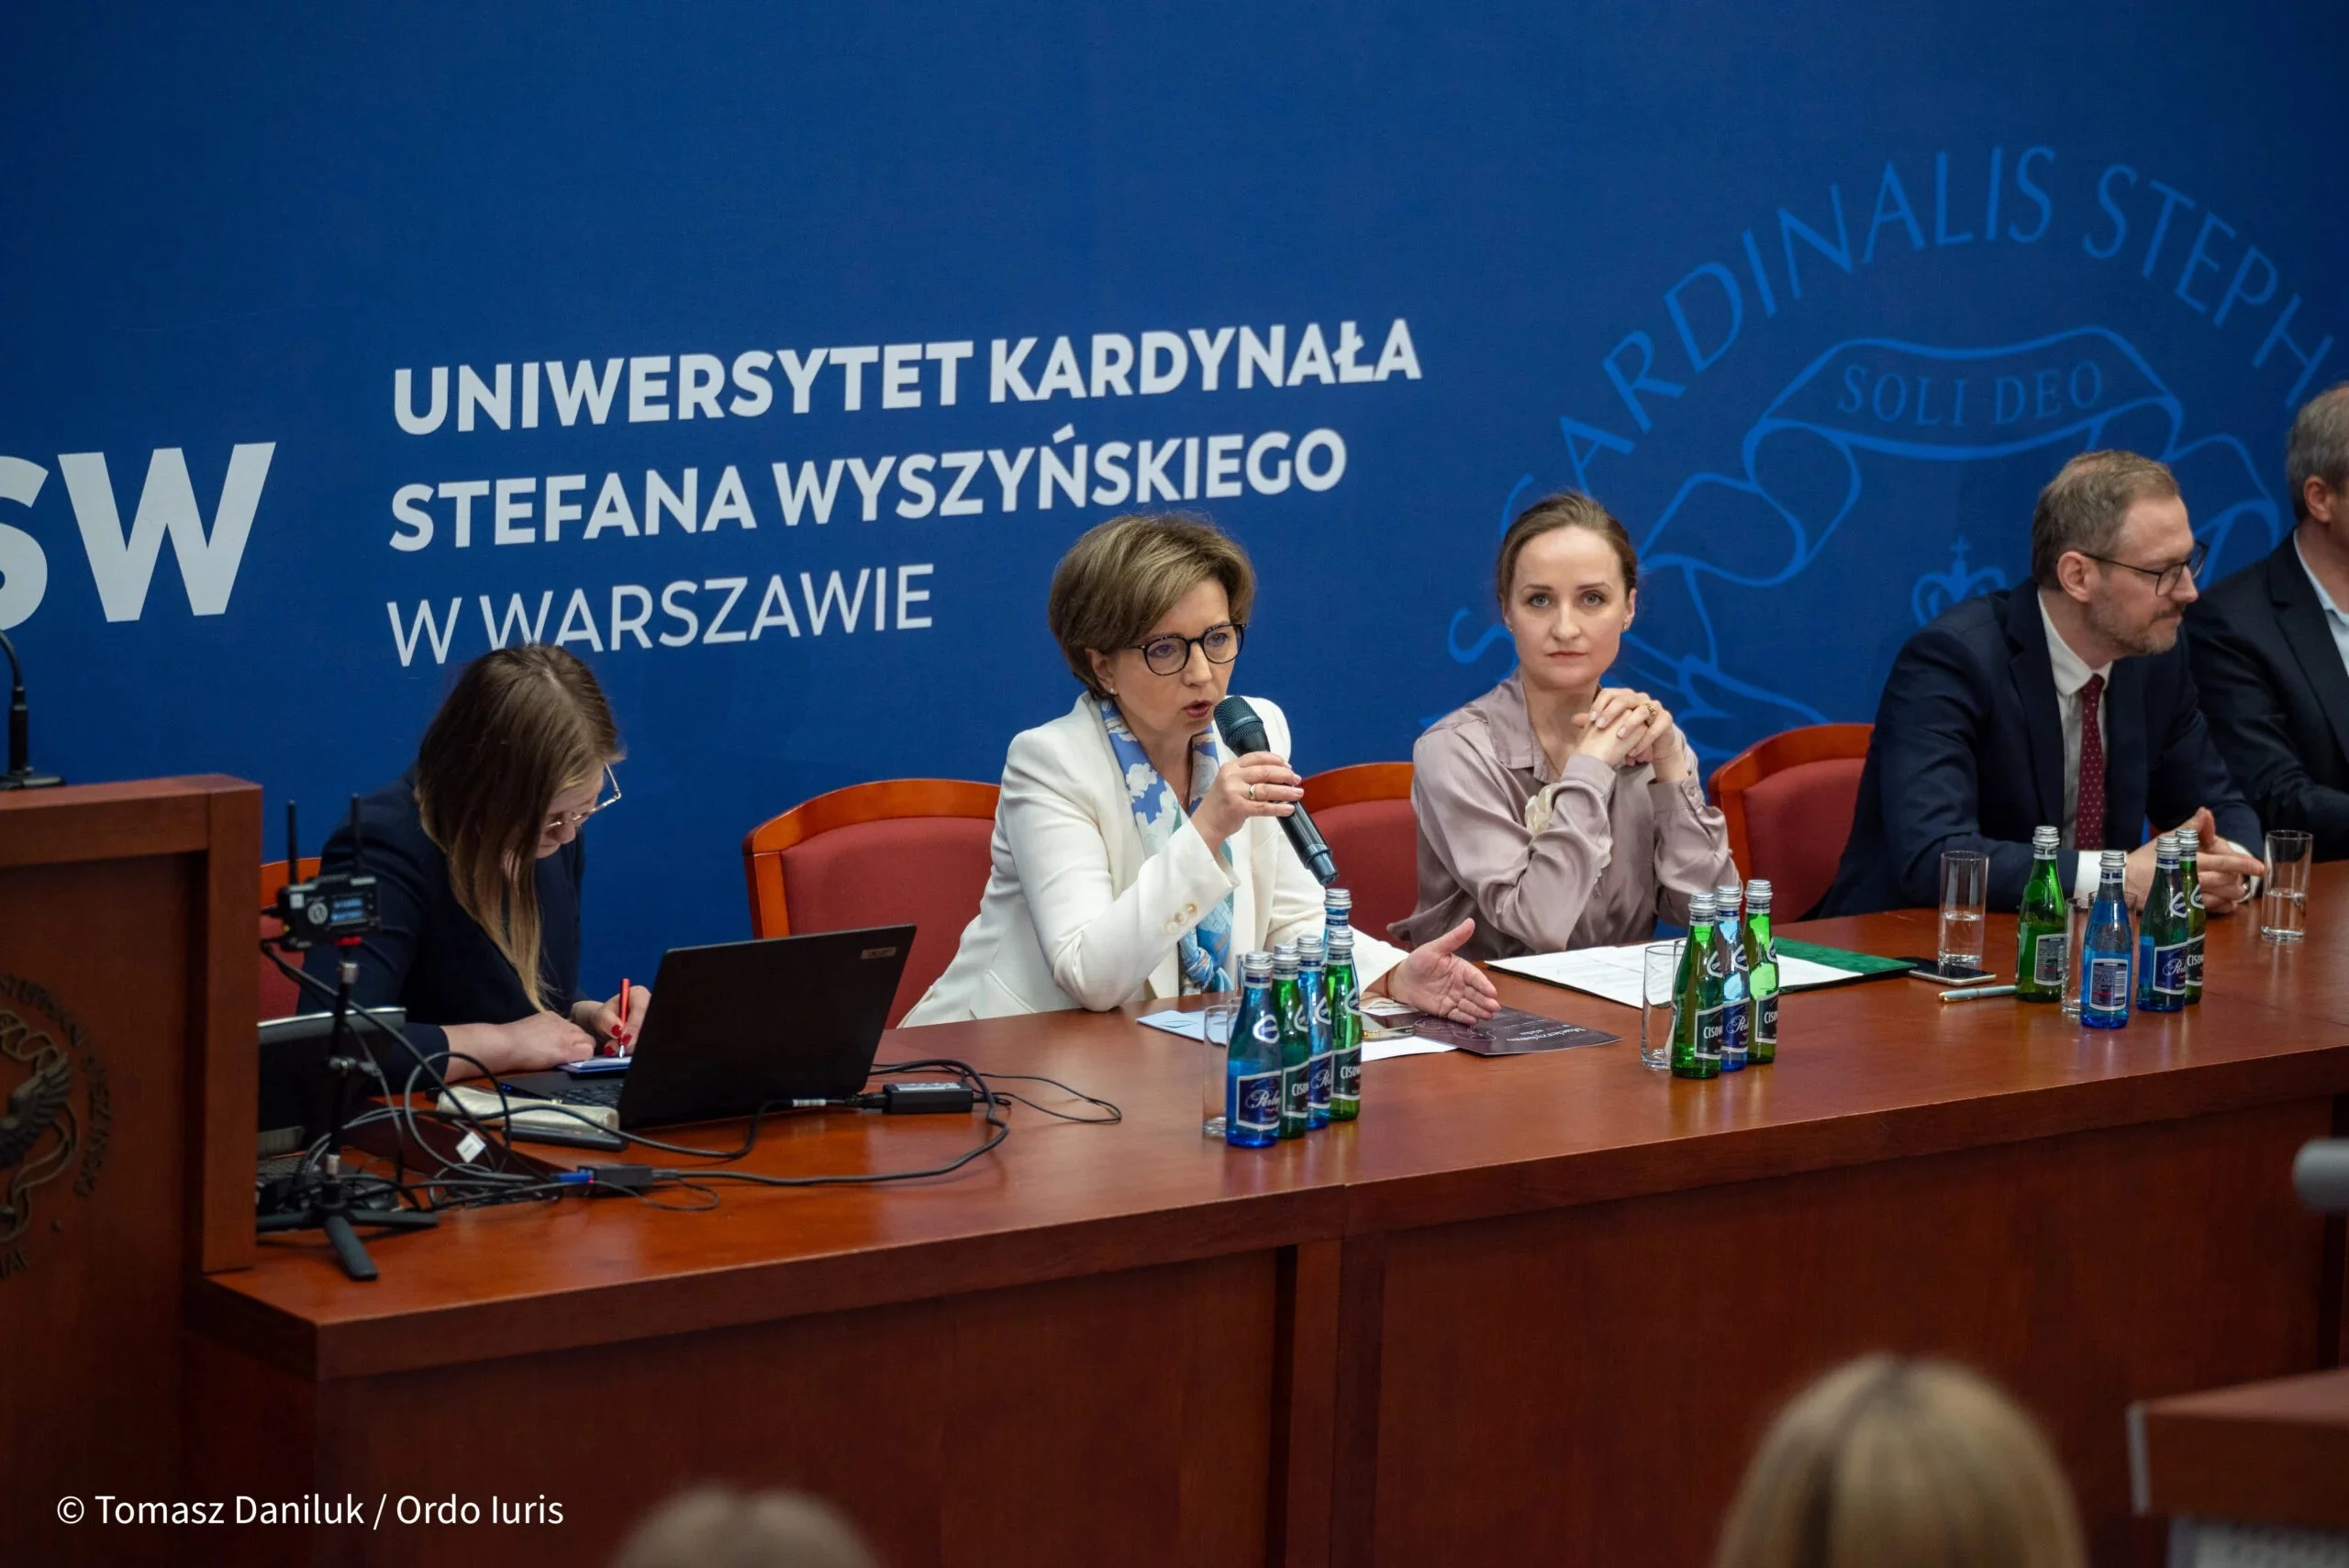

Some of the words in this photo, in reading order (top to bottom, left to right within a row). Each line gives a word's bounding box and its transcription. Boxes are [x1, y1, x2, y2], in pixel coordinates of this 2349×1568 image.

[394, 339, 974, 435] UNIWERSYTET
[989, 318, 1422, 404] KARDYNAŁA
[1837, 362, 1969, 428] SOLI
[1992, 360, 2103, 427] DEO
[389, 465, 757, 551] STEFANA
[772, 423, 1347, 527] WYSZYŃSKIEGO
[387, 597, 462, 667] W
[480, 563, 934, 652] WARSZAWIE
